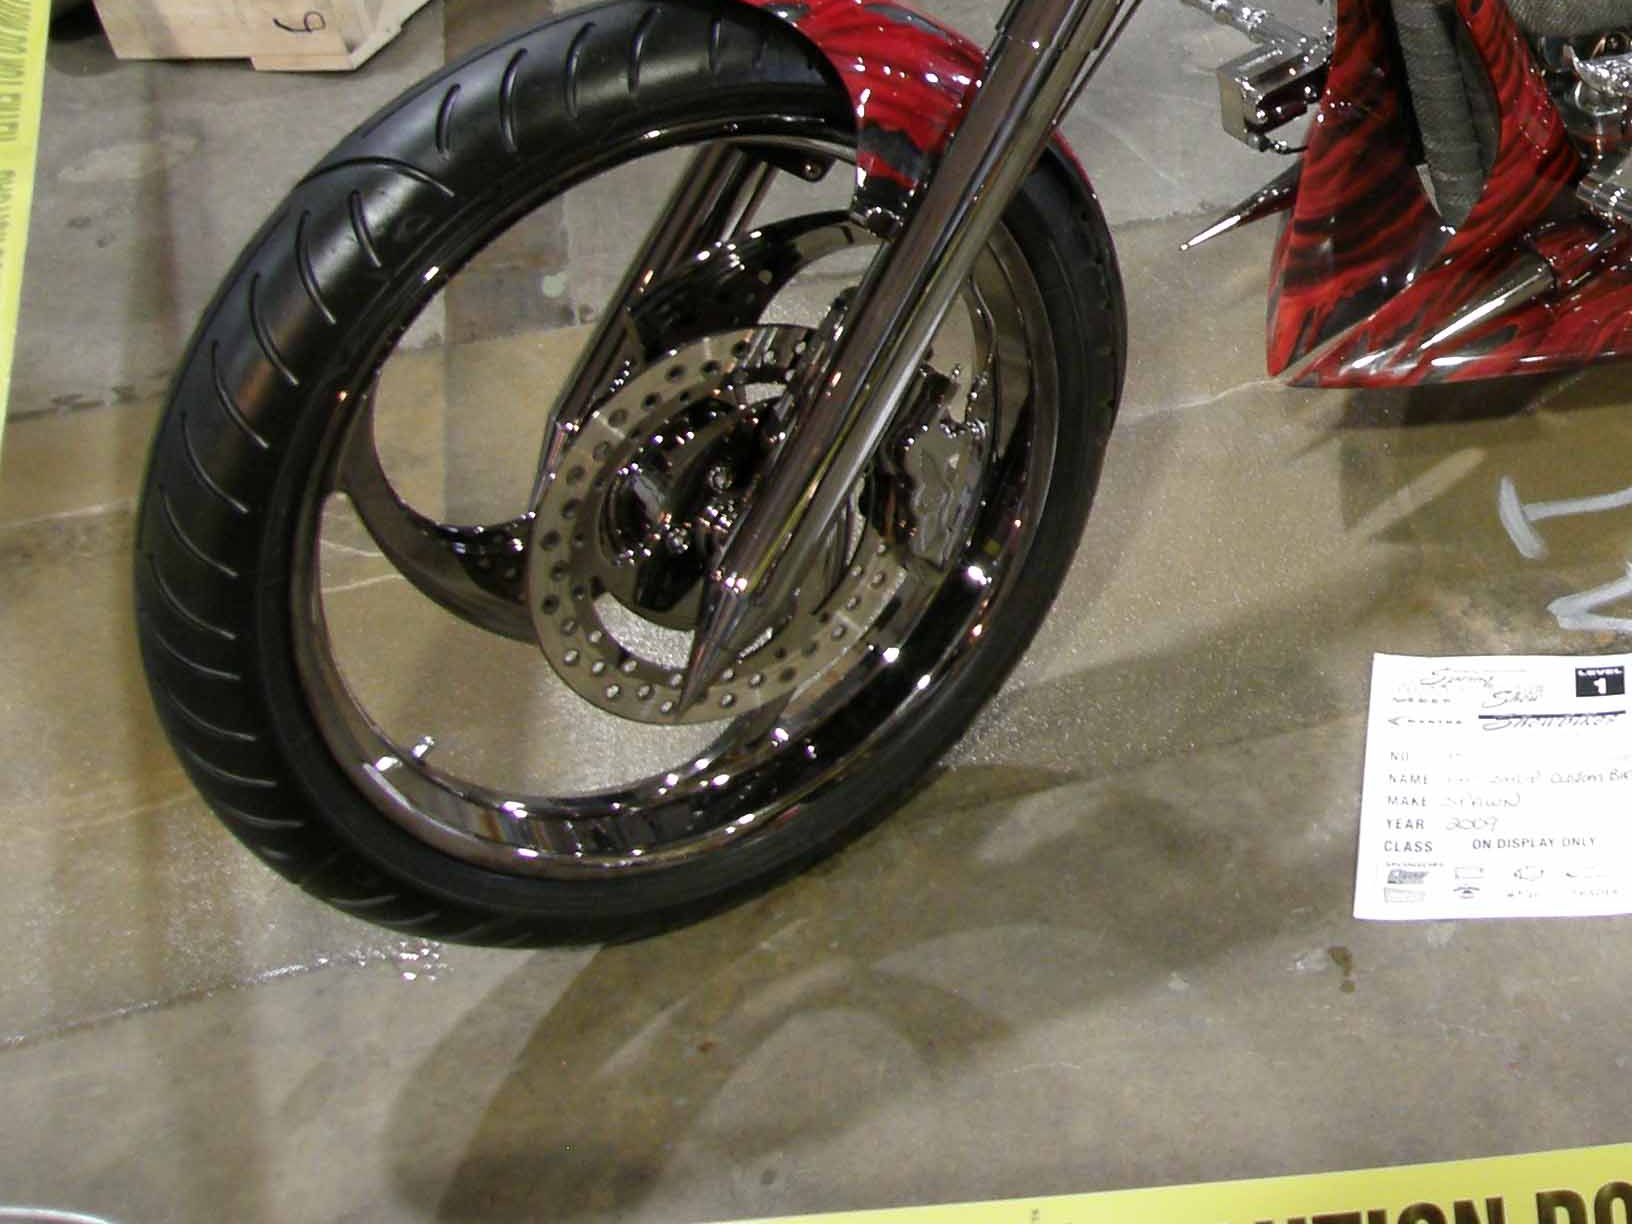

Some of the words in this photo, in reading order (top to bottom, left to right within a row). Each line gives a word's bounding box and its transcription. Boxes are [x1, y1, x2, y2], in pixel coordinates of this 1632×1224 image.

[1577, 667, 1624, 677] LEVEL
[1593, 677, 1608, 695] 1
[1388, 772, 1429, 785] NAME
[1387, 794, 1428, 807] MAKE
[1386, 817, 1425, 830] YEAR
[1383, 840, 1433, 853] CLASS
[1471, 838, 1492, 850] ON
[1496, 838, 1554, 849] DISPLAY
[1561, 837, 1596, 848] ONLY
